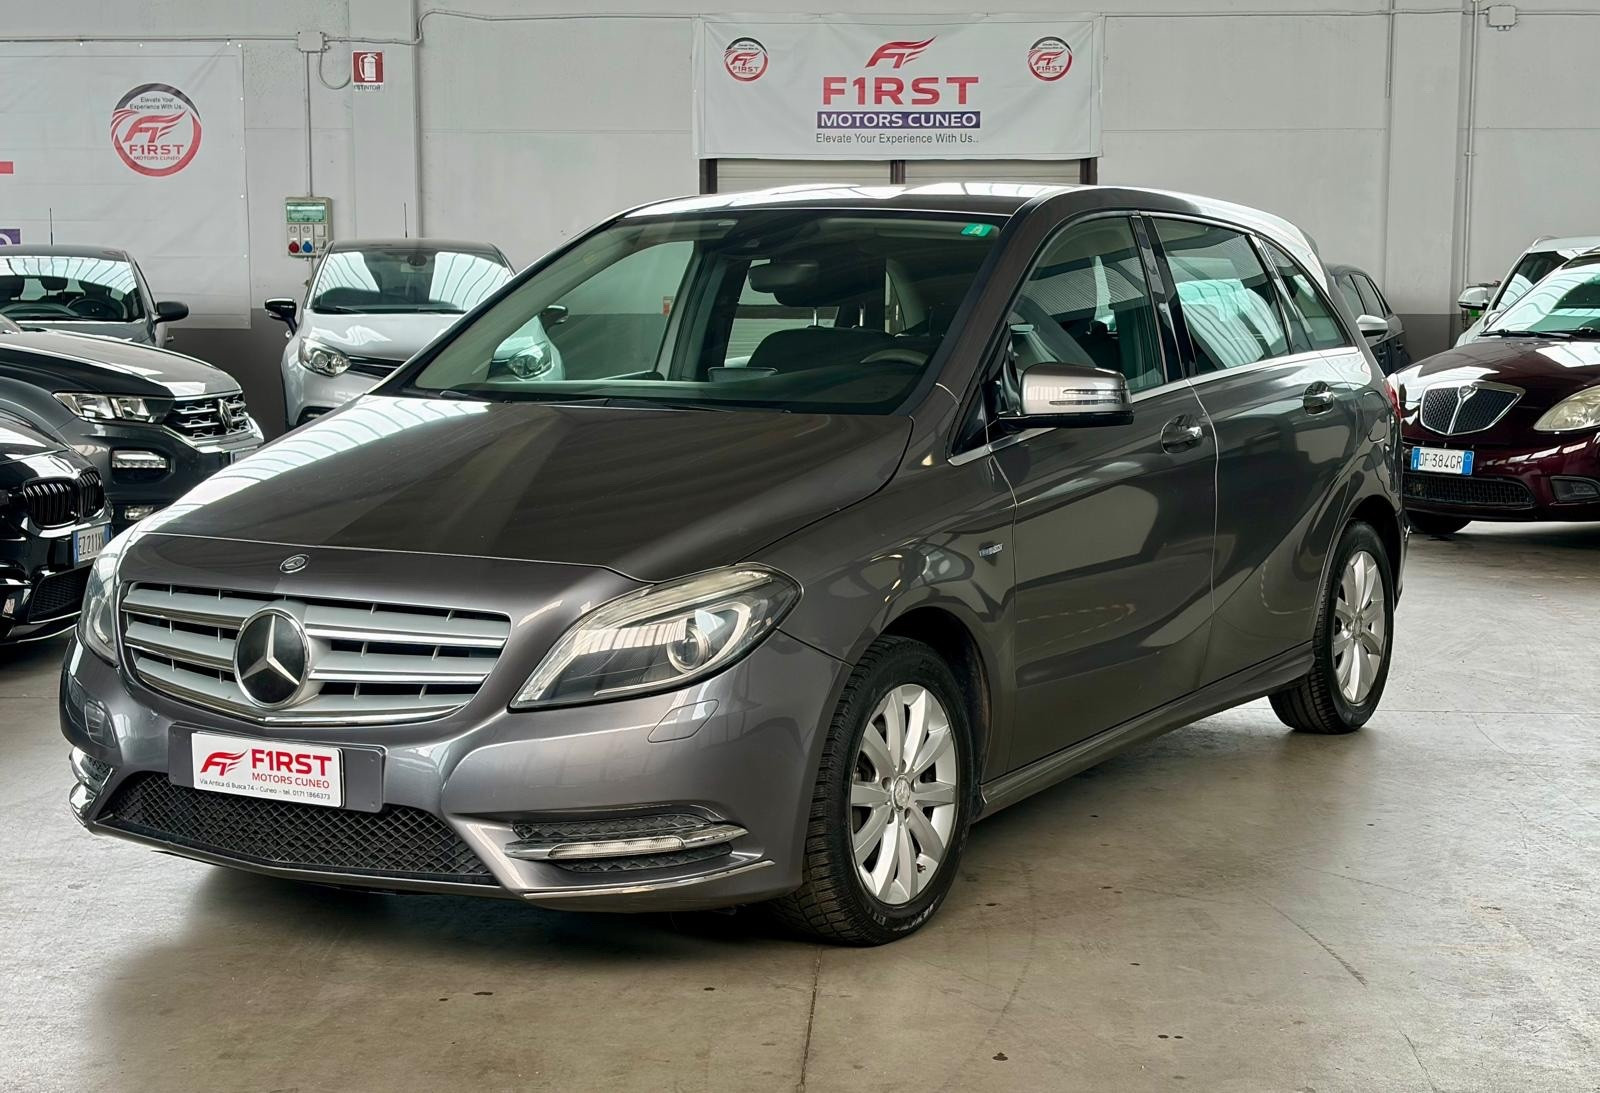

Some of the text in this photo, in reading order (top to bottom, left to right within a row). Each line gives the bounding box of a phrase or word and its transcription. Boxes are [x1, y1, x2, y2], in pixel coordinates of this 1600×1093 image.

[823, 76, 979, 105] F1RST
[821, 113, 977, 127] MOTORS CUNEO
[816, 132, 852, 144] Elevate
[854, 133, 876, 144] Your
[879, 133, 933, 145] Experience
[935, 132, 957, 144] With
[129, 144, 184, 155] F1RST
[251, 748, 332, 777] F1RST
[200, 777, 208, 785] Via
[209, 779, 225, 787] Antica
[232, 782, 247, 790] Busca
[260, 786, 277, 794] Cuneo
[252, 772, 330, 789] MOTORS CUNEO
